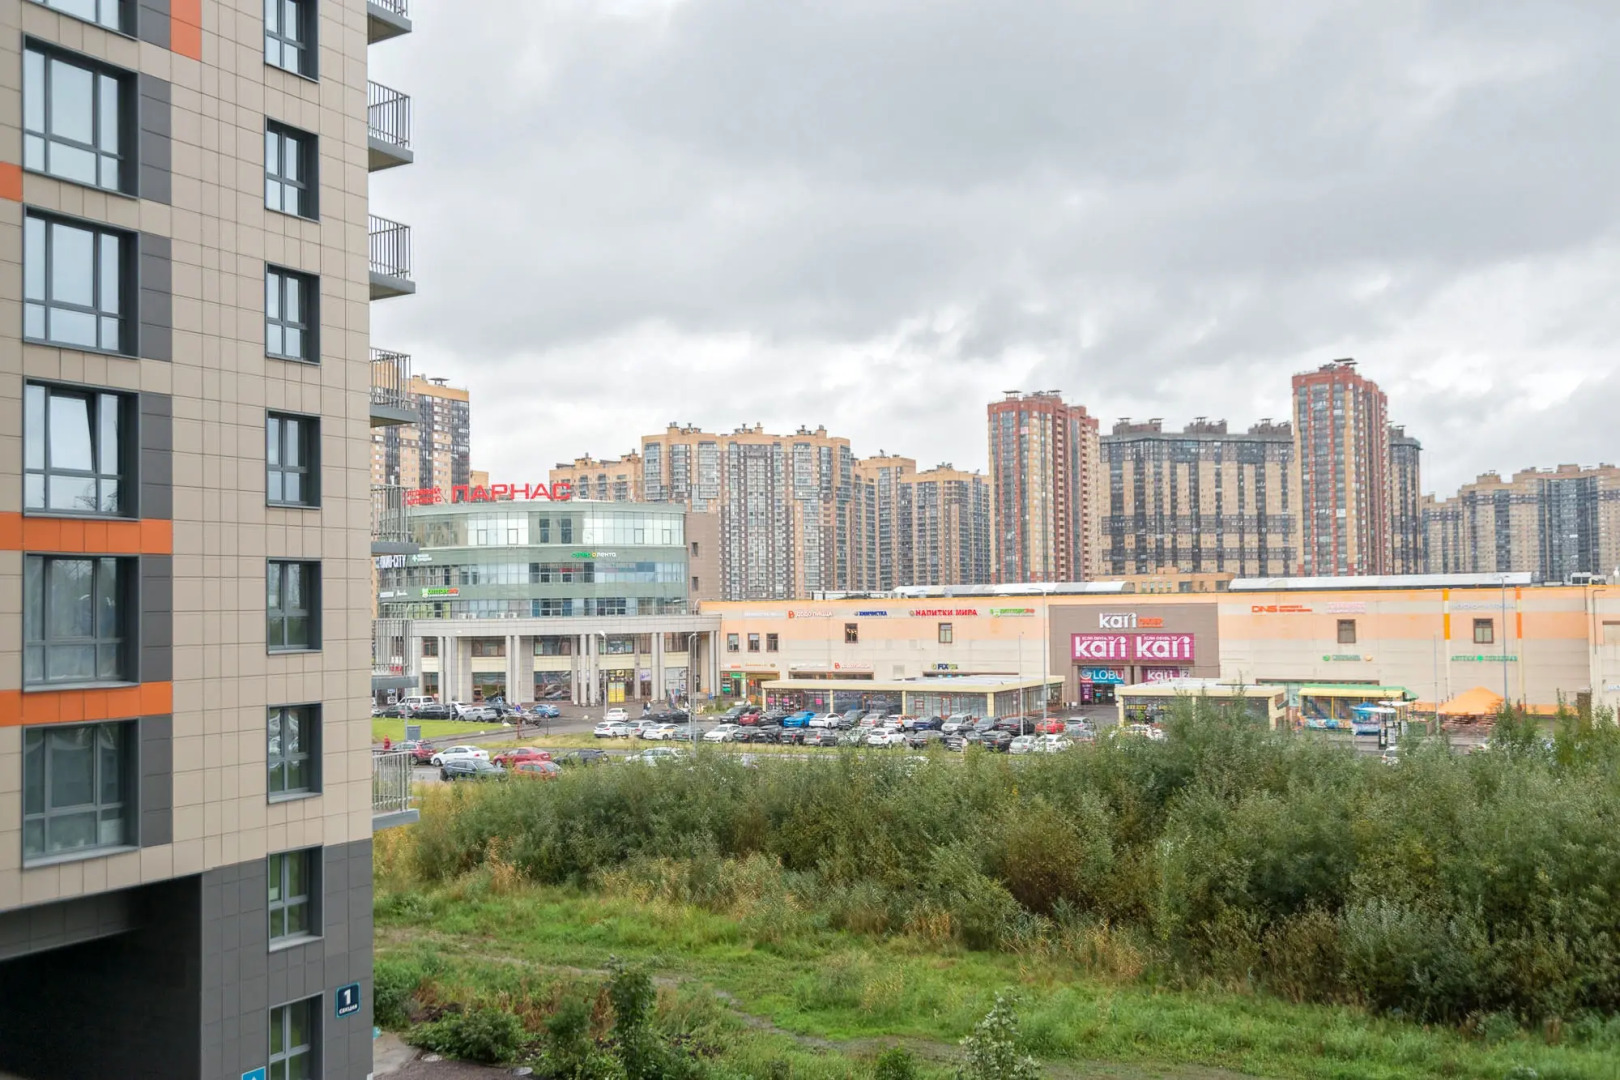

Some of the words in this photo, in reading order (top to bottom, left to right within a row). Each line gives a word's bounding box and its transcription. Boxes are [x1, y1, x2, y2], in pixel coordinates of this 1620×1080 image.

[452, 483, 571, 503] ПАРНАС
[916, 609, 953, 617] НАПИТКИ
[1251, 605, 1277, 613] DNS
[1099, 612, 1137, 628] kari
[1075, 636, 1127, 657] kari
[1136, 636, 1190, 658] kari
[1147, 670, 1173, 681] kari
[343, 988, 351, 1005] 1
